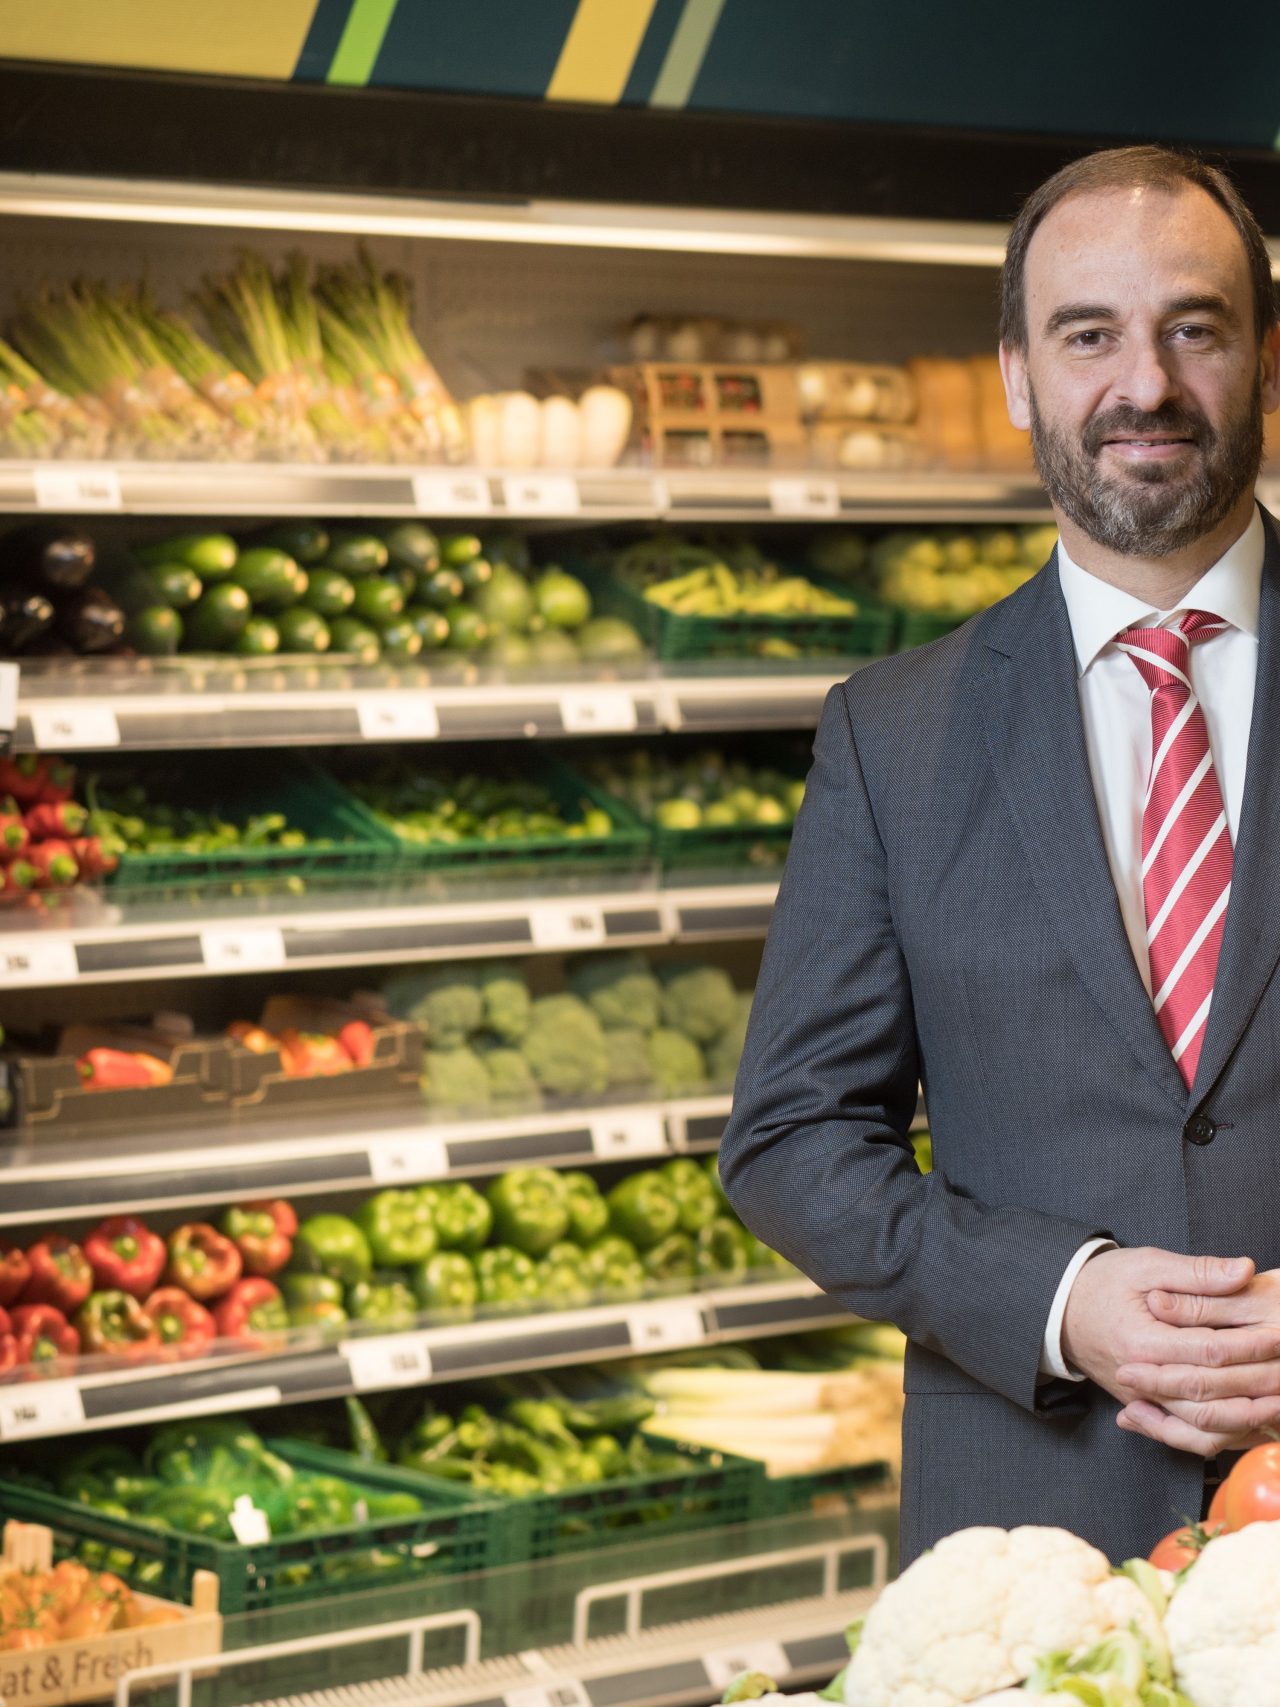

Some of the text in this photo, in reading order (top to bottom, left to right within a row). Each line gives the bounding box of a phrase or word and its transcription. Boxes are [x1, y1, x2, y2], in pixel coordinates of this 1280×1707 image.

[0, 1639, 154, 1698] at & Fresh
